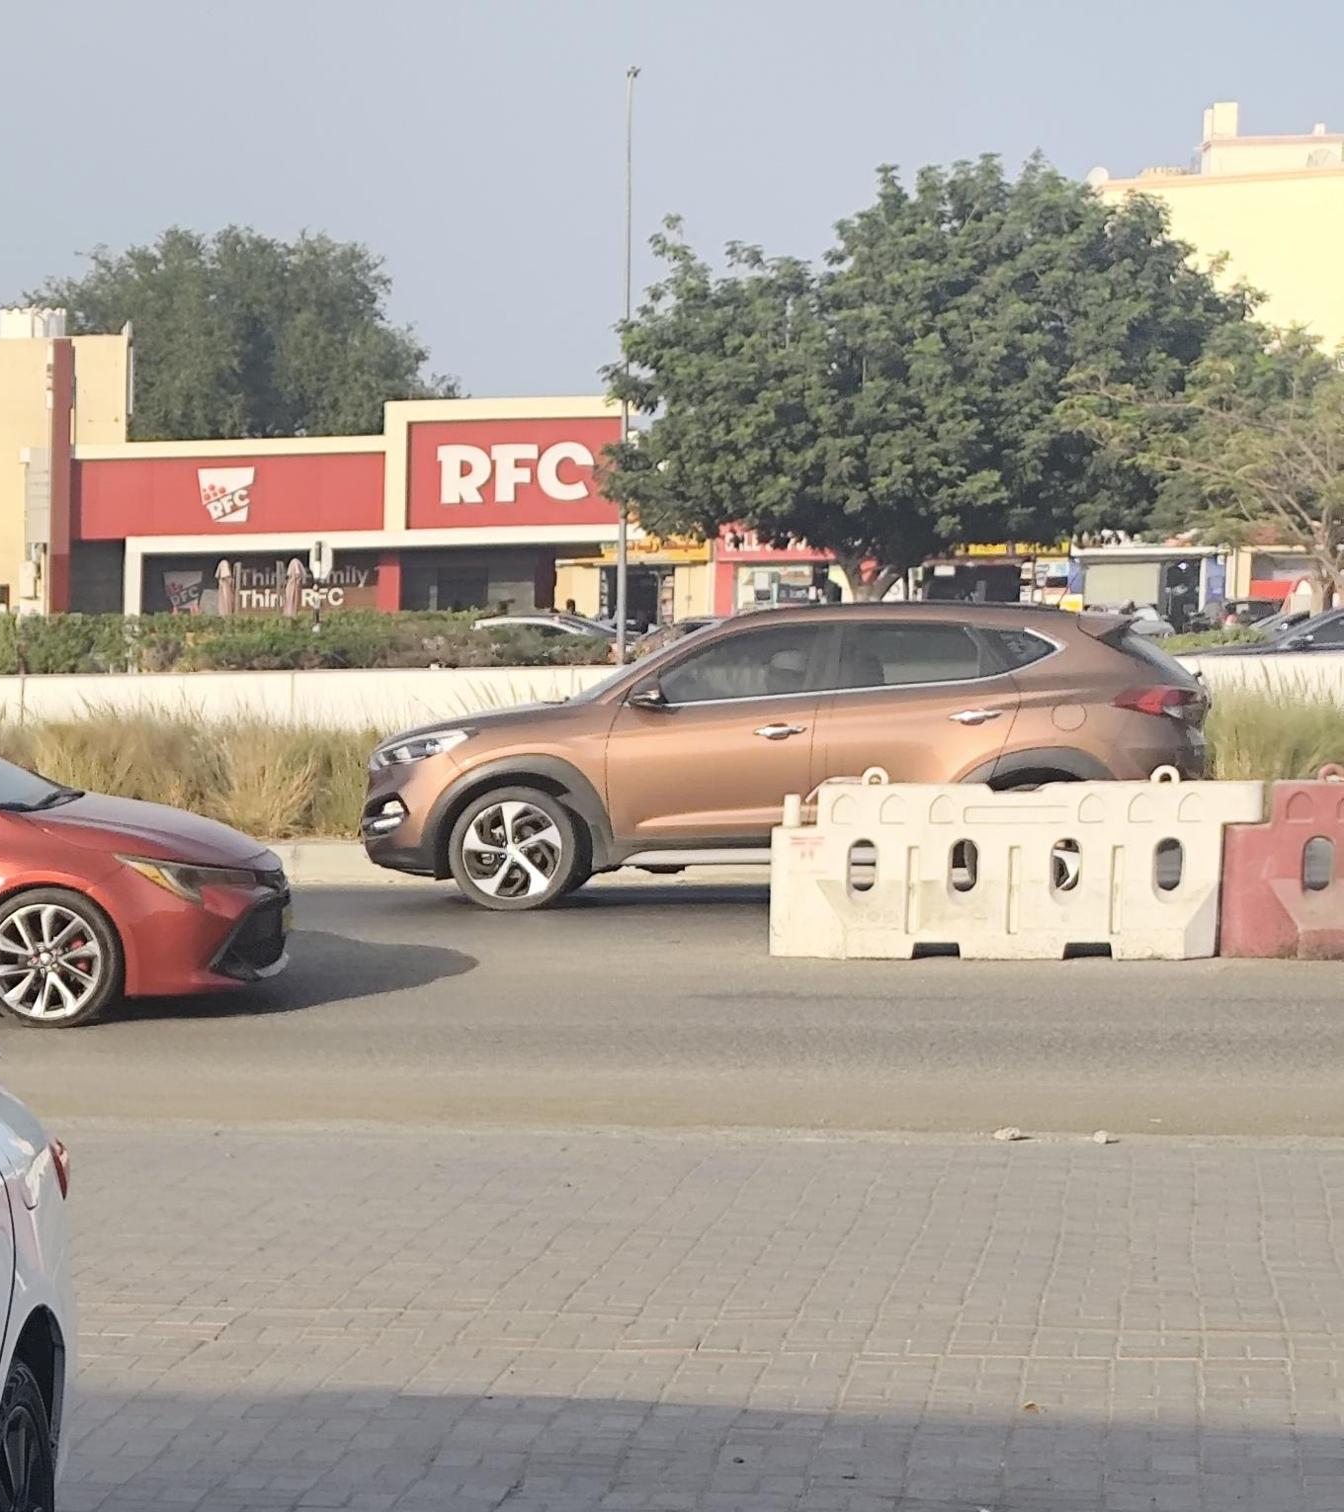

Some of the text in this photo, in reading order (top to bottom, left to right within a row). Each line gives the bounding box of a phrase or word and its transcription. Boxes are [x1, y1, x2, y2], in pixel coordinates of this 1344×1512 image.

[437, 441, 595, 504] RFC
[206, 489, 250, 519] RFC
[239, 588, 283, 608] Thin
